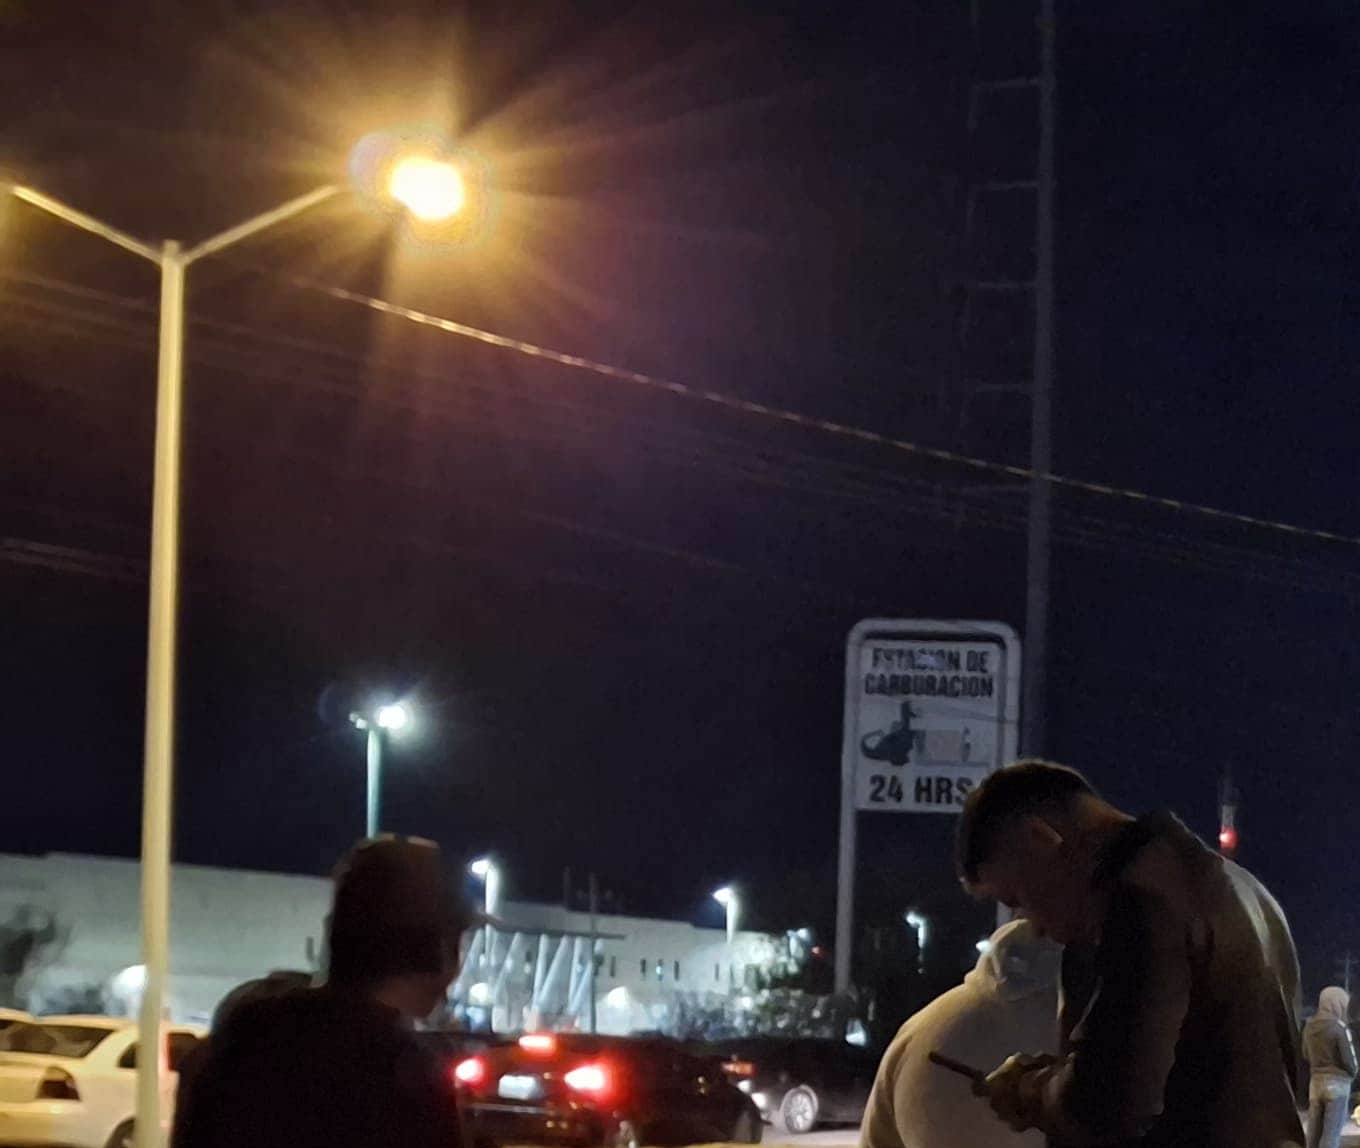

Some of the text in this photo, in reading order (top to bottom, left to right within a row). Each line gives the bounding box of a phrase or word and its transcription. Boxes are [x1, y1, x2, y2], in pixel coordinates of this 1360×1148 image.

[965, 649, 990, 673] DE
[864, 672, 994, 698] CARBURACION
[869, 774, 974, 806] 24 HRS
